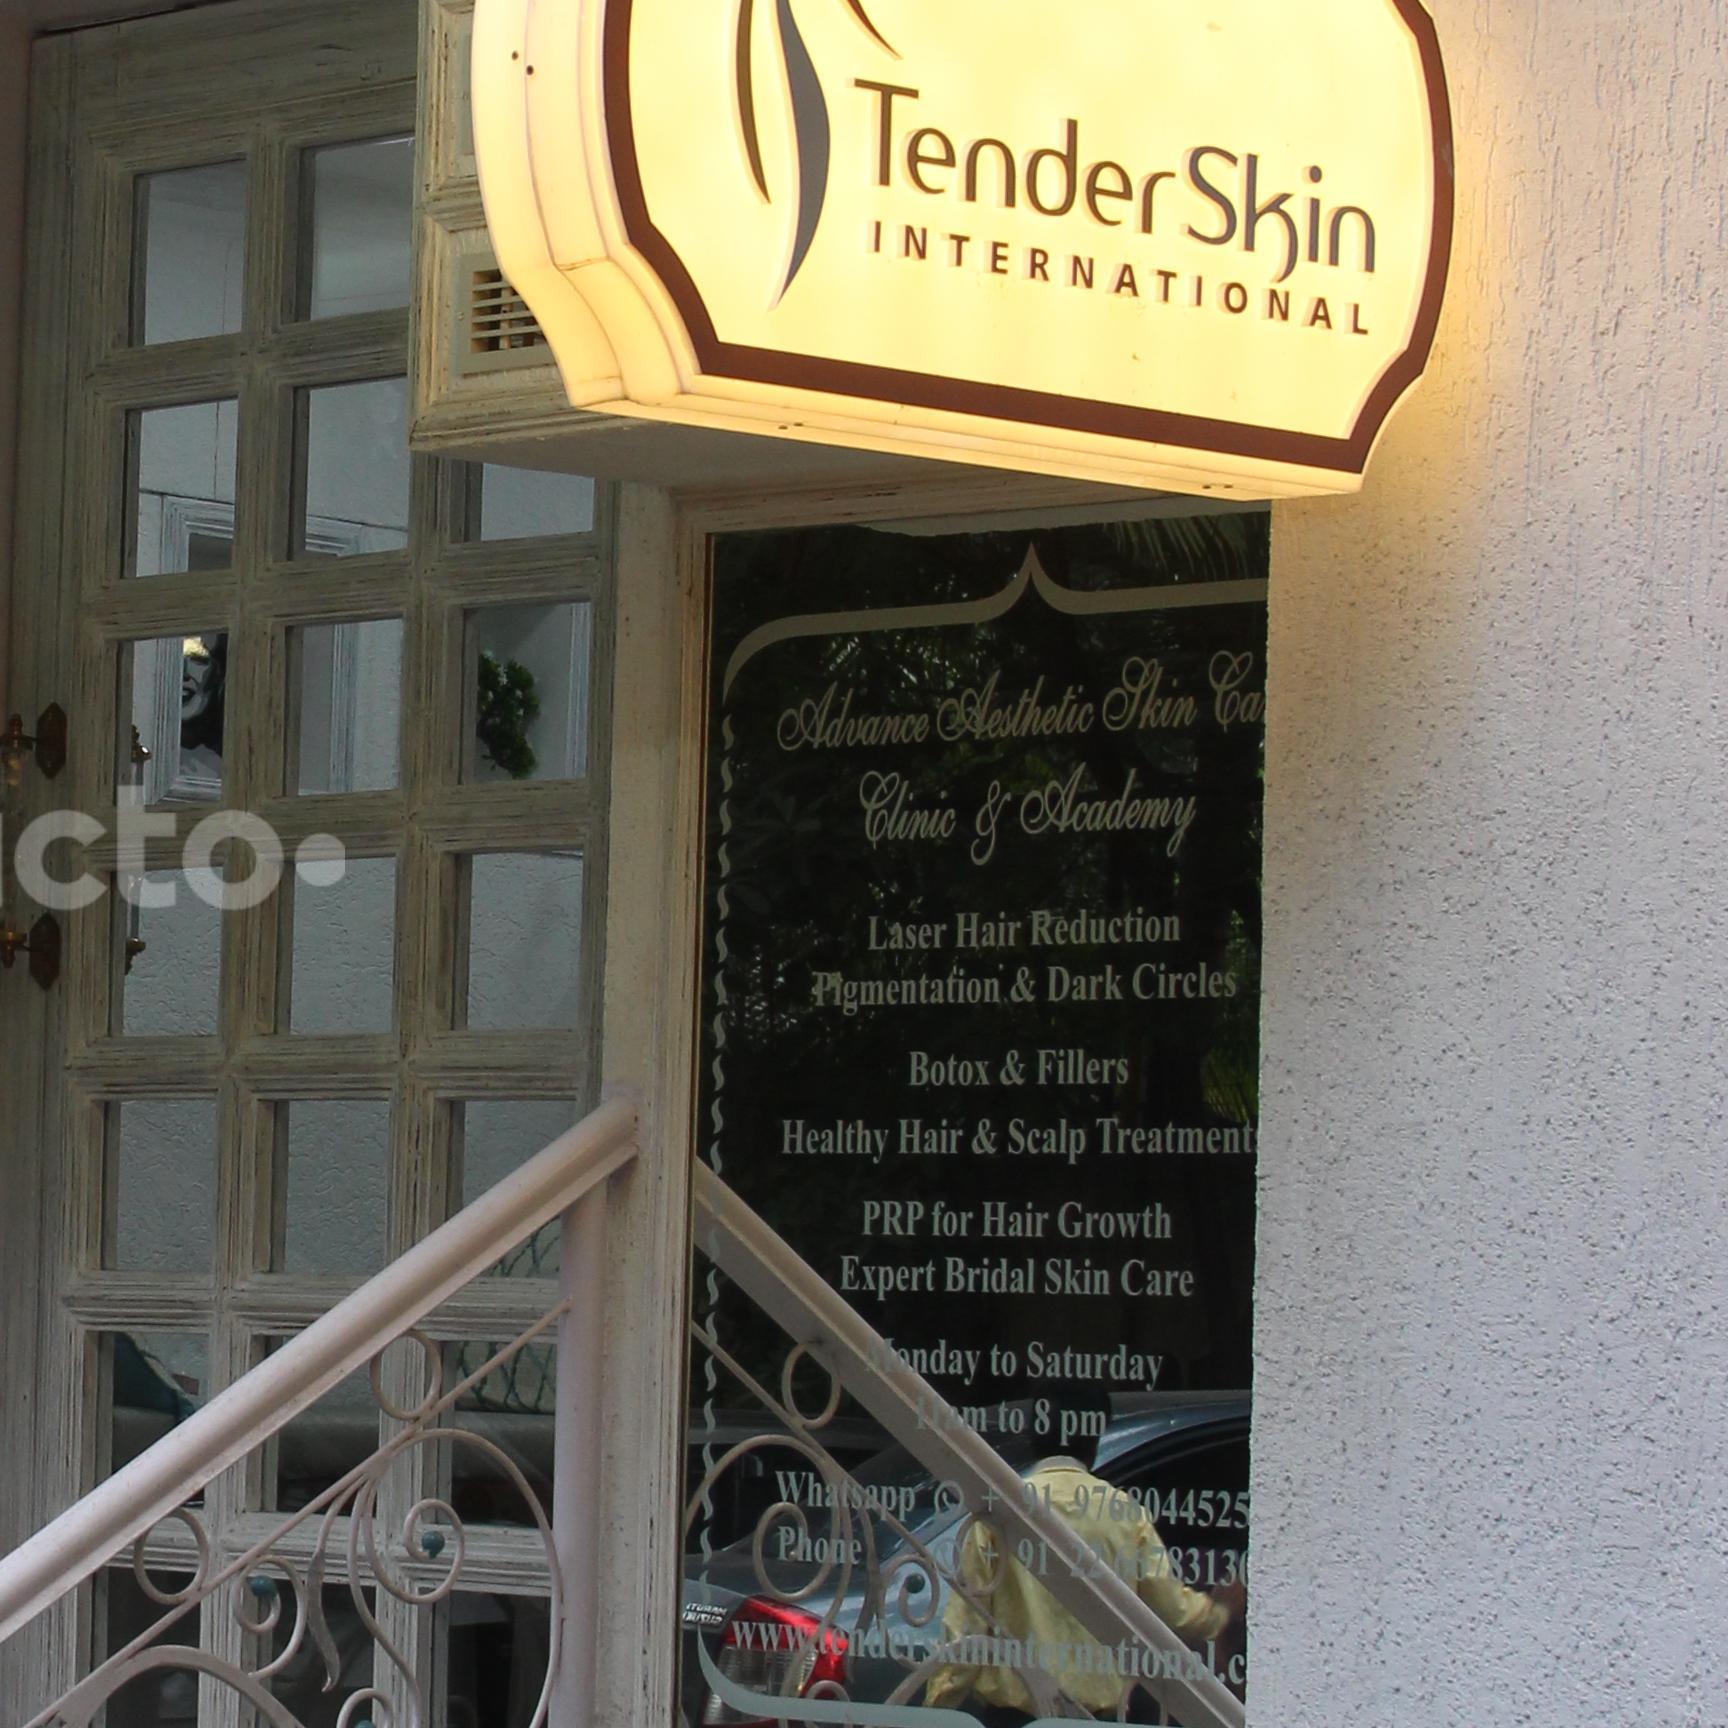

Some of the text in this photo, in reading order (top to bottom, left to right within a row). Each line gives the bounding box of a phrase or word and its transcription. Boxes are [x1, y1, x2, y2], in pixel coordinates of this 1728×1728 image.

[854, 78, 1375, 282] TenderSkin
[872, 221, 1370, 338] INTERNATIONAL
[776, 650, 1265, 752] Advance Aesthetic Skin Ca
[859, 762, 1197, 866] Clinic & Academy
[868, 907, 1181, 952] Laser Hair Reduction
[815, 961, 1237, 1017] Pigmentation & Dark Circles
[908, 1048, 1130, 1087] Botox & Fillers
[781, 1118, 1258, 1165] Healthy Hair & Scalp Treatment
[862, 1200, 1173, 1240] PRP for Hair Growth
[839, 1255, 1195, 1301] Expert Bridal Skin Care
[990, 1343, 1018, 1378] to
[1026, 1340, 1163, 1392] Saturday
[997, 1400, 1025, 1435] to
[1033, 1398, 1052, 1435] 8
[1059, 1408, 1108, 1447] pm
[774, 1470, 916, 1522] Whatsapp
[777, 1524, 862, 1567] Phone
